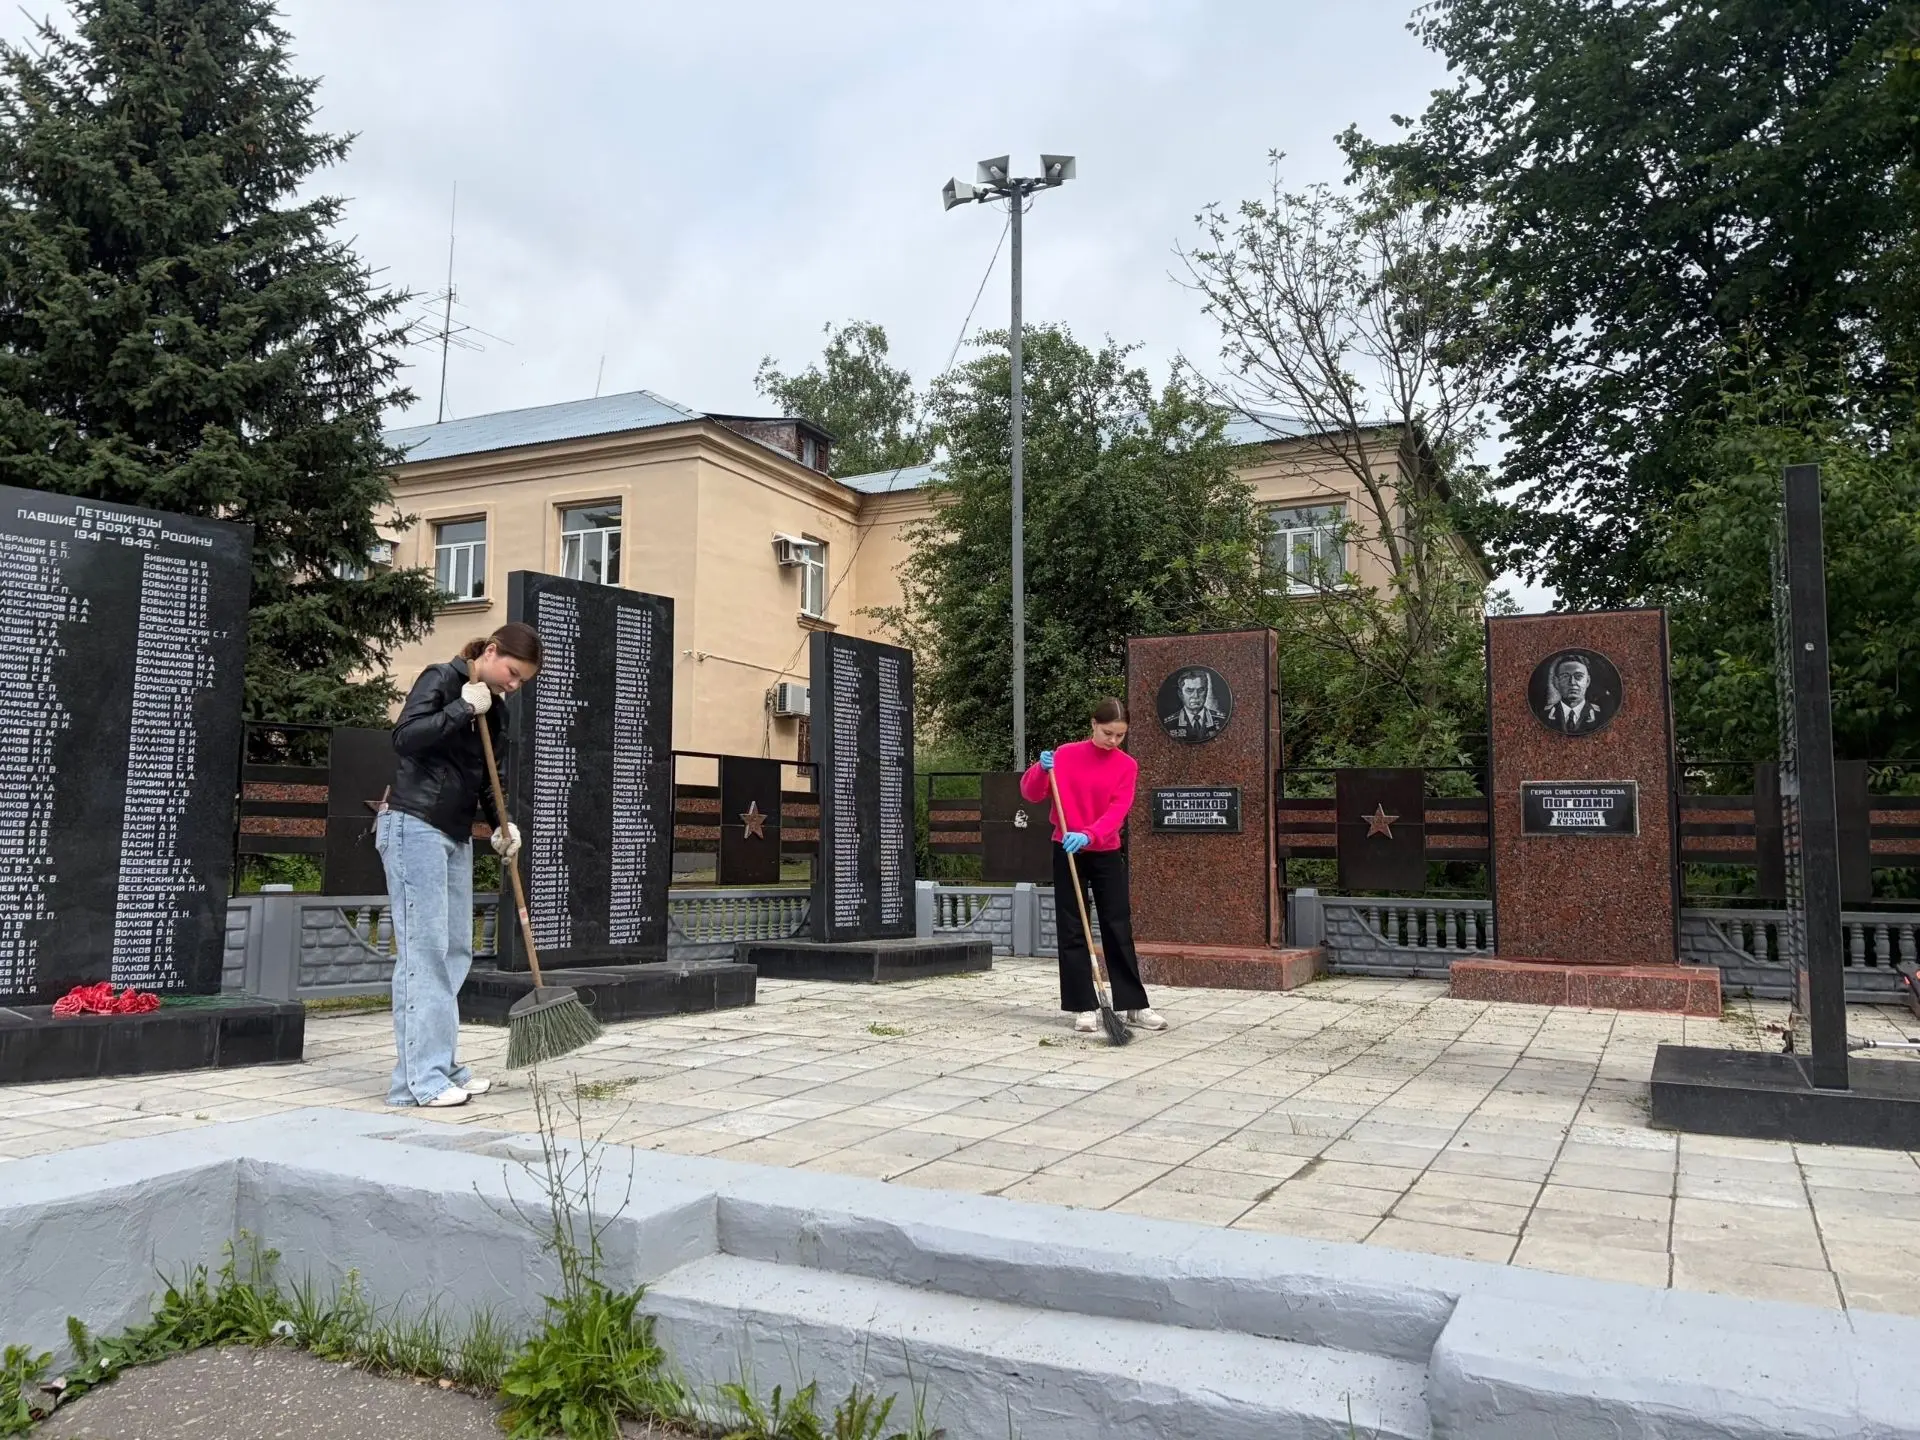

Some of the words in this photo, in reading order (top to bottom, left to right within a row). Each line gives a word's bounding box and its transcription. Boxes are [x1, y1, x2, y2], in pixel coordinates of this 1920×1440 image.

[76, 506, 162, 529] ПЕТУШИНЦЫ
[17, 510, 77, 527] ПАВШИЕ
[82, 519, 91, 529] В
[96, 521, 133, 535] БОЯХ
[138, 528, 155, 538] ЗА
[160, 530, 213, 548] РОДИНУ
[74, 530, 100, 541] 1941
[121, 536, 152, 549] 1945
[143, 554, 186, 565] БИБИКОВ
[143, 562, 189, 574] БОБЫЛЕВ
[0, 570, 37, 581] КИМОВ
[142, 571, 188, 583] БОБЫЛЕВ
[140, 597, 186, 608] БОБЫЛЕВ
[139, 614, 185, 625] БОБЫЛЕВ
[138, 622, 209, 635] БОГОСЛОВСКИЙ
[138, 631, 187, 642] БОДРИХИН
[137, 639, 181, 650] БОЛОТОВ
[135, 666, 193, 677] БОЛЬШАКОВ
[133, 683, 177, 692] БОРИСОВ
[132, 691, 171, 700] БОЧКИН
[132, 700, 170, 709] БОЧКИН
[131, 709, 170, 718] БОЧКИН
[131, 718, 170, 727] БРЫКИН
[130, 727, 176, 736] БУЛАНОВ
[129, 744, 174, 753] БУЛАНОВ
[128, 753, 174, 762] БУЛАНОВ
[127, 761, 173, 770] БУЛАНОВ
[127, 770, 172, 779] БУЛАНОВ
[126, 779, 164, 787] БУРДИН
[125, 787, 170, 796] БУЯНКИН
[124, 796, 165, 804] БЫЧКОВ
[1163, 799, 1228, 810] МЯСНИКОВ
[1543, 797, 1613, 808] ПОГОДИН
[124, 805, 162, 813] ВАЛЯЕВ
[123, 814, 156, 822] ВАНИН
[112, 946, 151, 954] ВОЛКОВ
